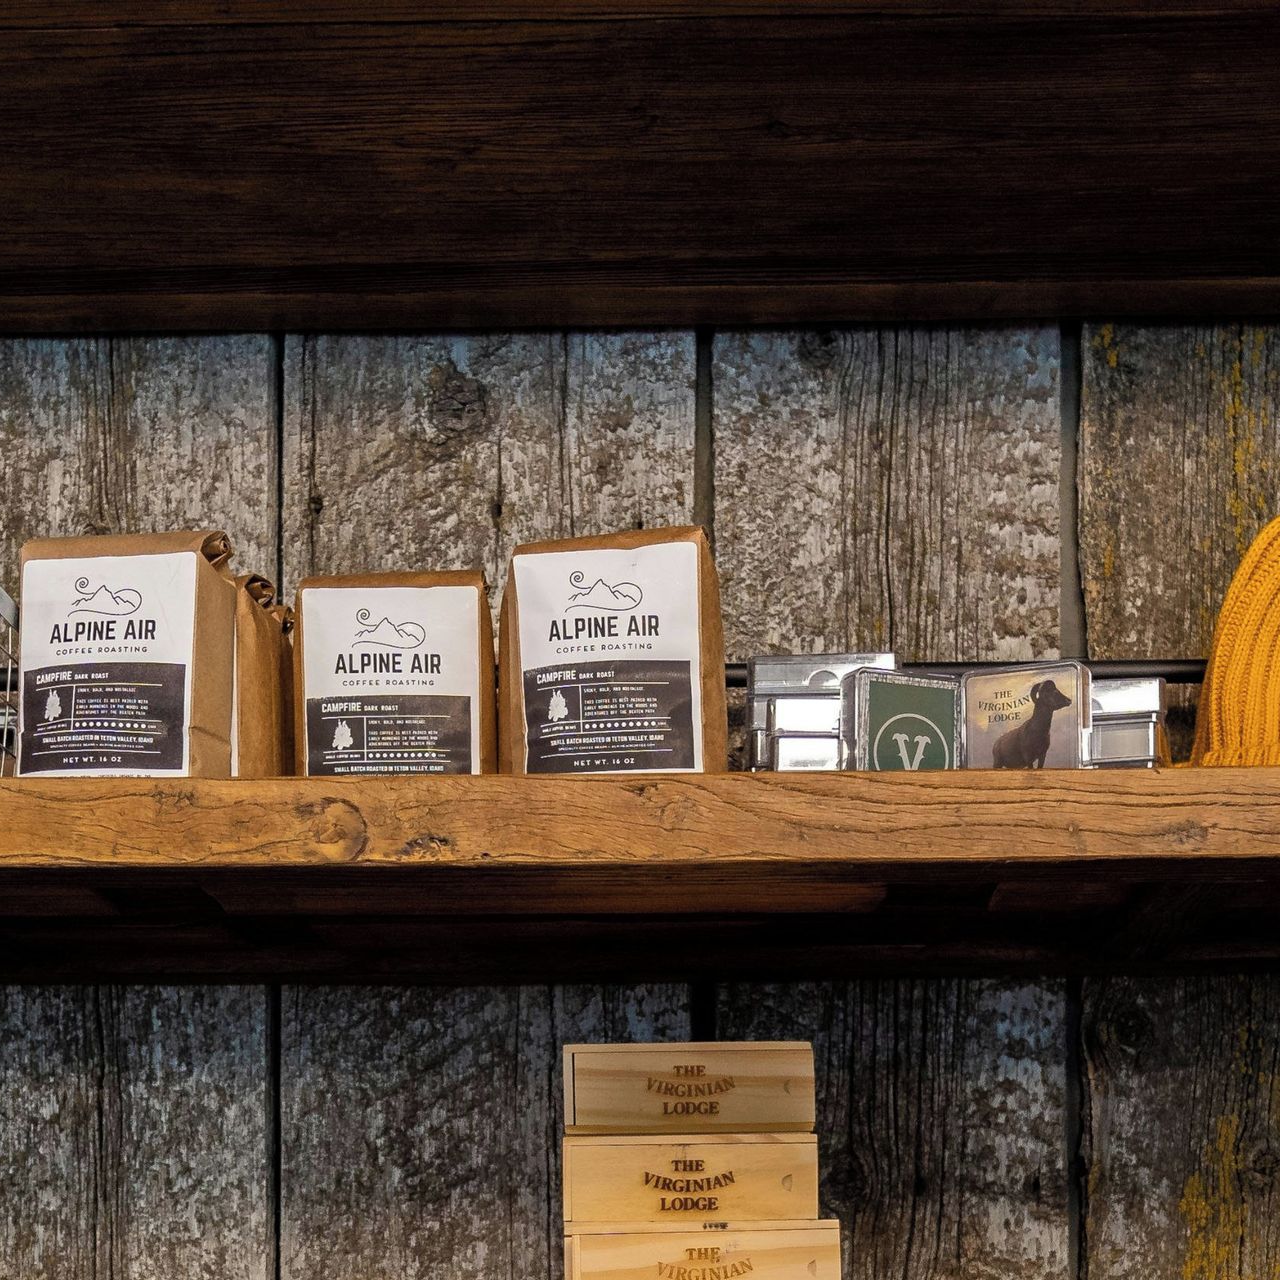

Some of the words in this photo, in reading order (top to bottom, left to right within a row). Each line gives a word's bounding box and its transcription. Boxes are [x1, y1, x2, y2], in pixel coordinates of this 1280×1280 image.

[50, 620, 117, 644] ALPINE
[124, 619, 156, 640] AIR
[548, 616, 618, 642] ALPINE
[627, 615, 660, 637] AIR
[56, 647, 92, 656] COFFEE
[556, 645, 595, 654] COFFEE
[601, 643, 652, 651] ROASTING
[335, 653, 402, 674] ALPINE
[410, 653, 441, 674] AIR
[36, 671, 72, 684] CAMPFIRE
[537, 670, 576, 684] CAMPFIRE
[994, 690, 1013, 699] THE
[321, 702, 362, 713] CAMPFIRE
[978, 694, 1031, 712] VIRGINIAN
[988, 711, 1022, 724] LODGE
[673, 1065, 706, 1078] THE
[646, 1076, 736, 1098] VIRGINIAN
[663, 1102, 720, 1116] LODGE
[671, 1160, 705, 1172] THE
[643, 1170, 736, 1193] VIRGINIAN
[660, 1197, 719, 1212] LODGE
